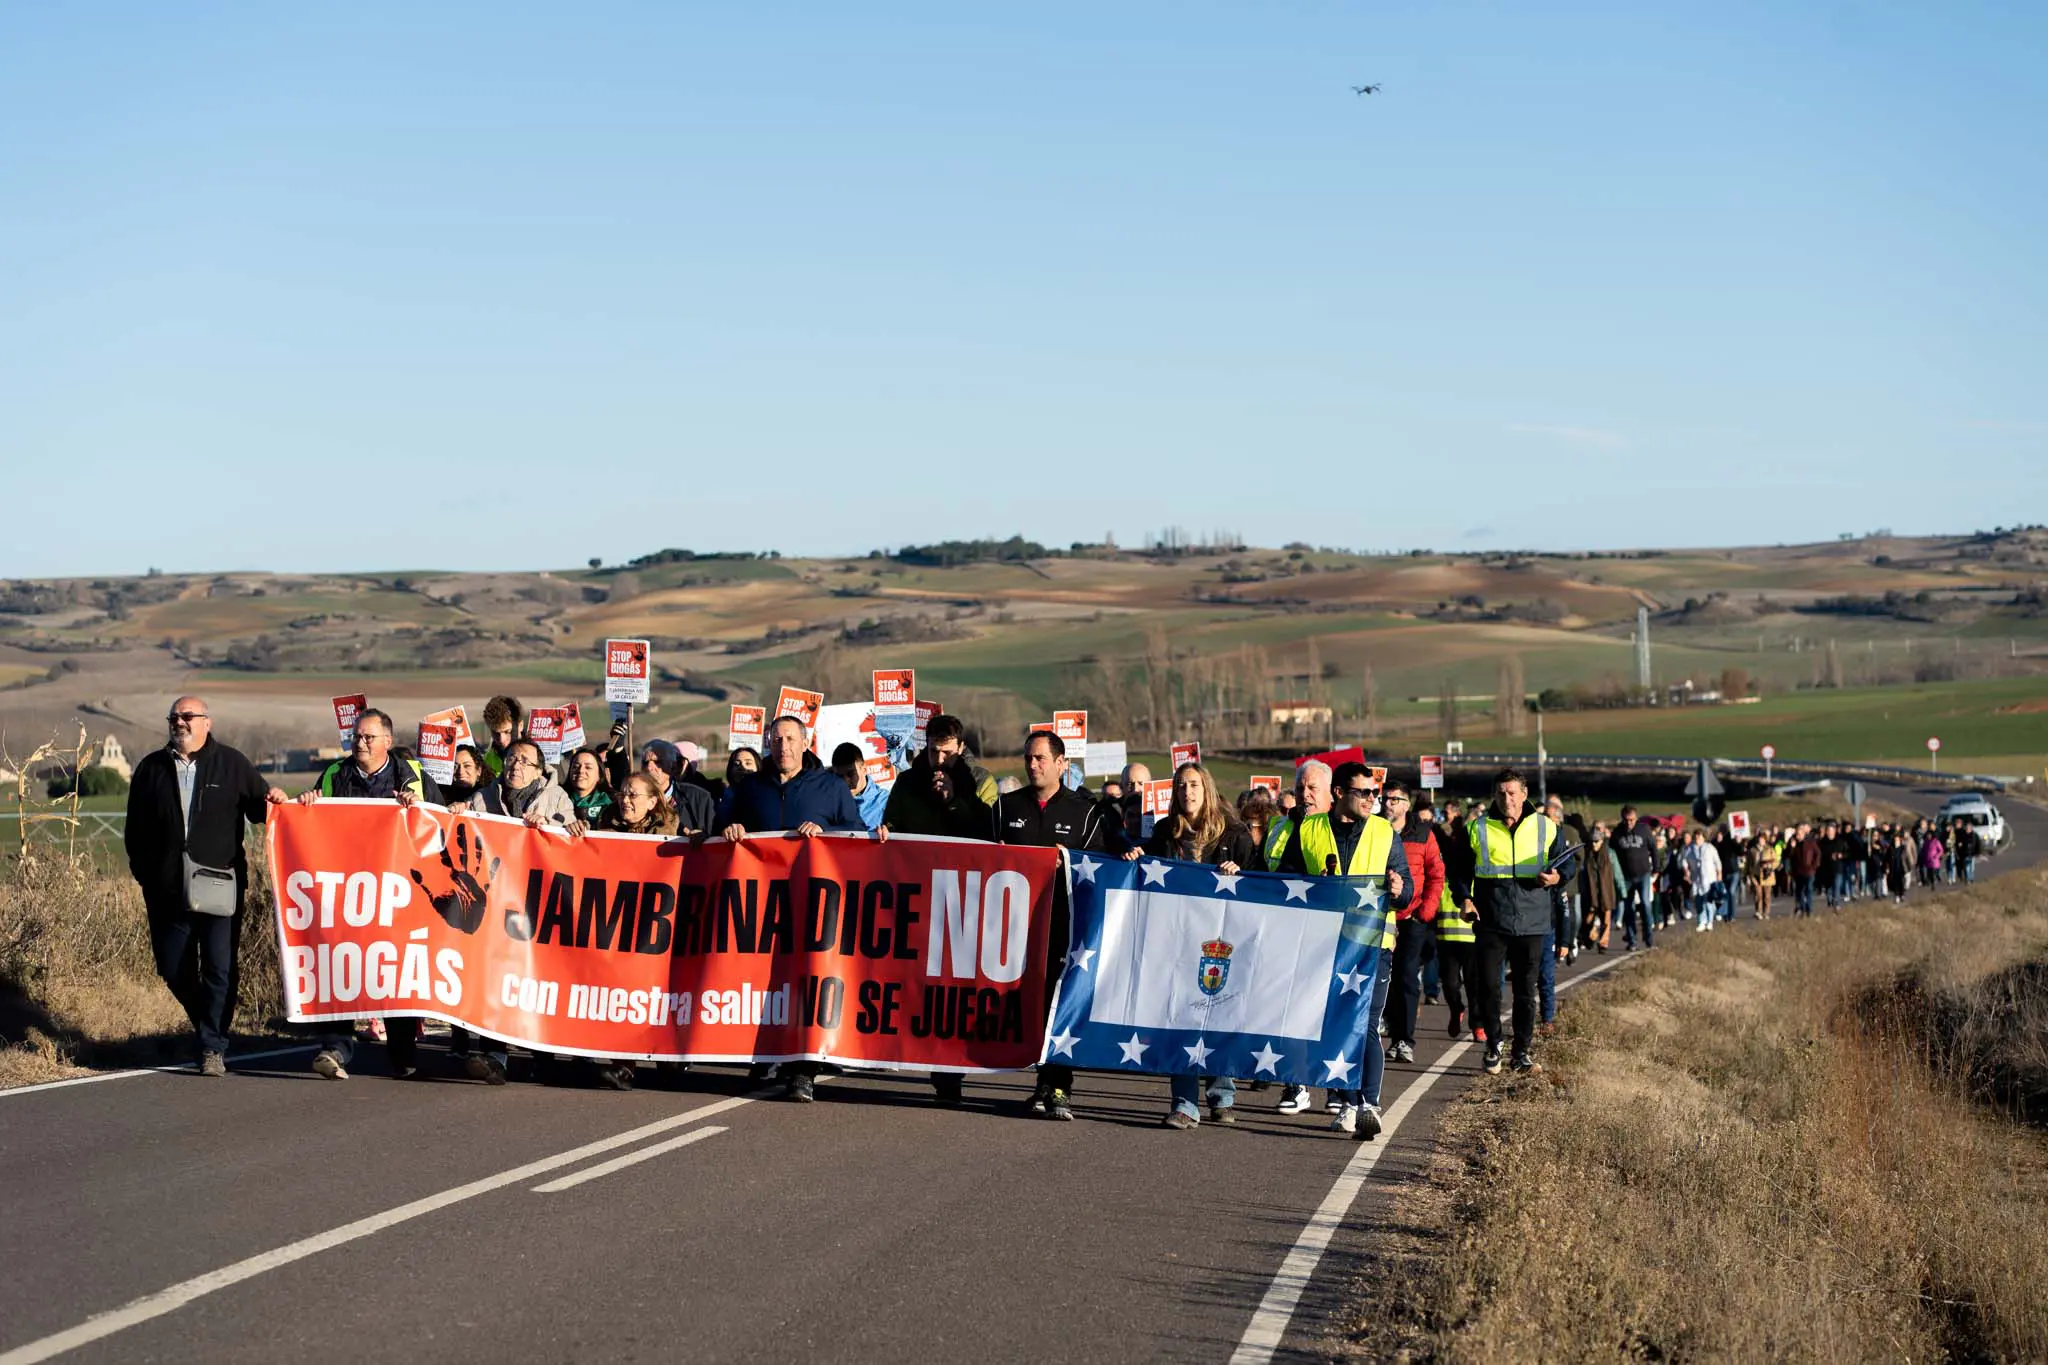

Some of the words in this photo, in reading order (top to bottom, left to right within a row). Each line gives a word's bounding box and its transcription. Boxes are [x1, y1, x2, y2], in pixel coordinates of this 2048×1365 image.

[611, 651, 632, 662] STOP
[611, 661, 640, 674] BIOGÁS
[878, 680, 899, 691] STOP
[878, 689, 908, 702] BIOGÁS
[337, 704, 355, 716] STOP
[783, 697, 805, 710] STOP
[735, 713, 752, 722] STOP
[916, 708, 931, 718] STOP
[532, 717, 552, 728] STOP
[421, 732, 442, 744] STOP
[531, 726, 558, 739] BIOGÁS
[420, 742, 449, 757] BIOGÁS
[286, 871, 412, 930] STOP
[505, 868, 794, 956] JAMBRINA
[803, 877, 921, 960] DICE
[926, 869, 1031, 983] NO
[287, 927, 464, 1006] BIOGÁS
[502, 973, 560, 1016] con
[568, 984, 692, 1026] nuestra
[701, 982, 791, 1025] salud
[799, 975, 845, 1030] NO
[856, 980, 902, 1036] SE
[911, 985, 1023, 1044] JUEGA
